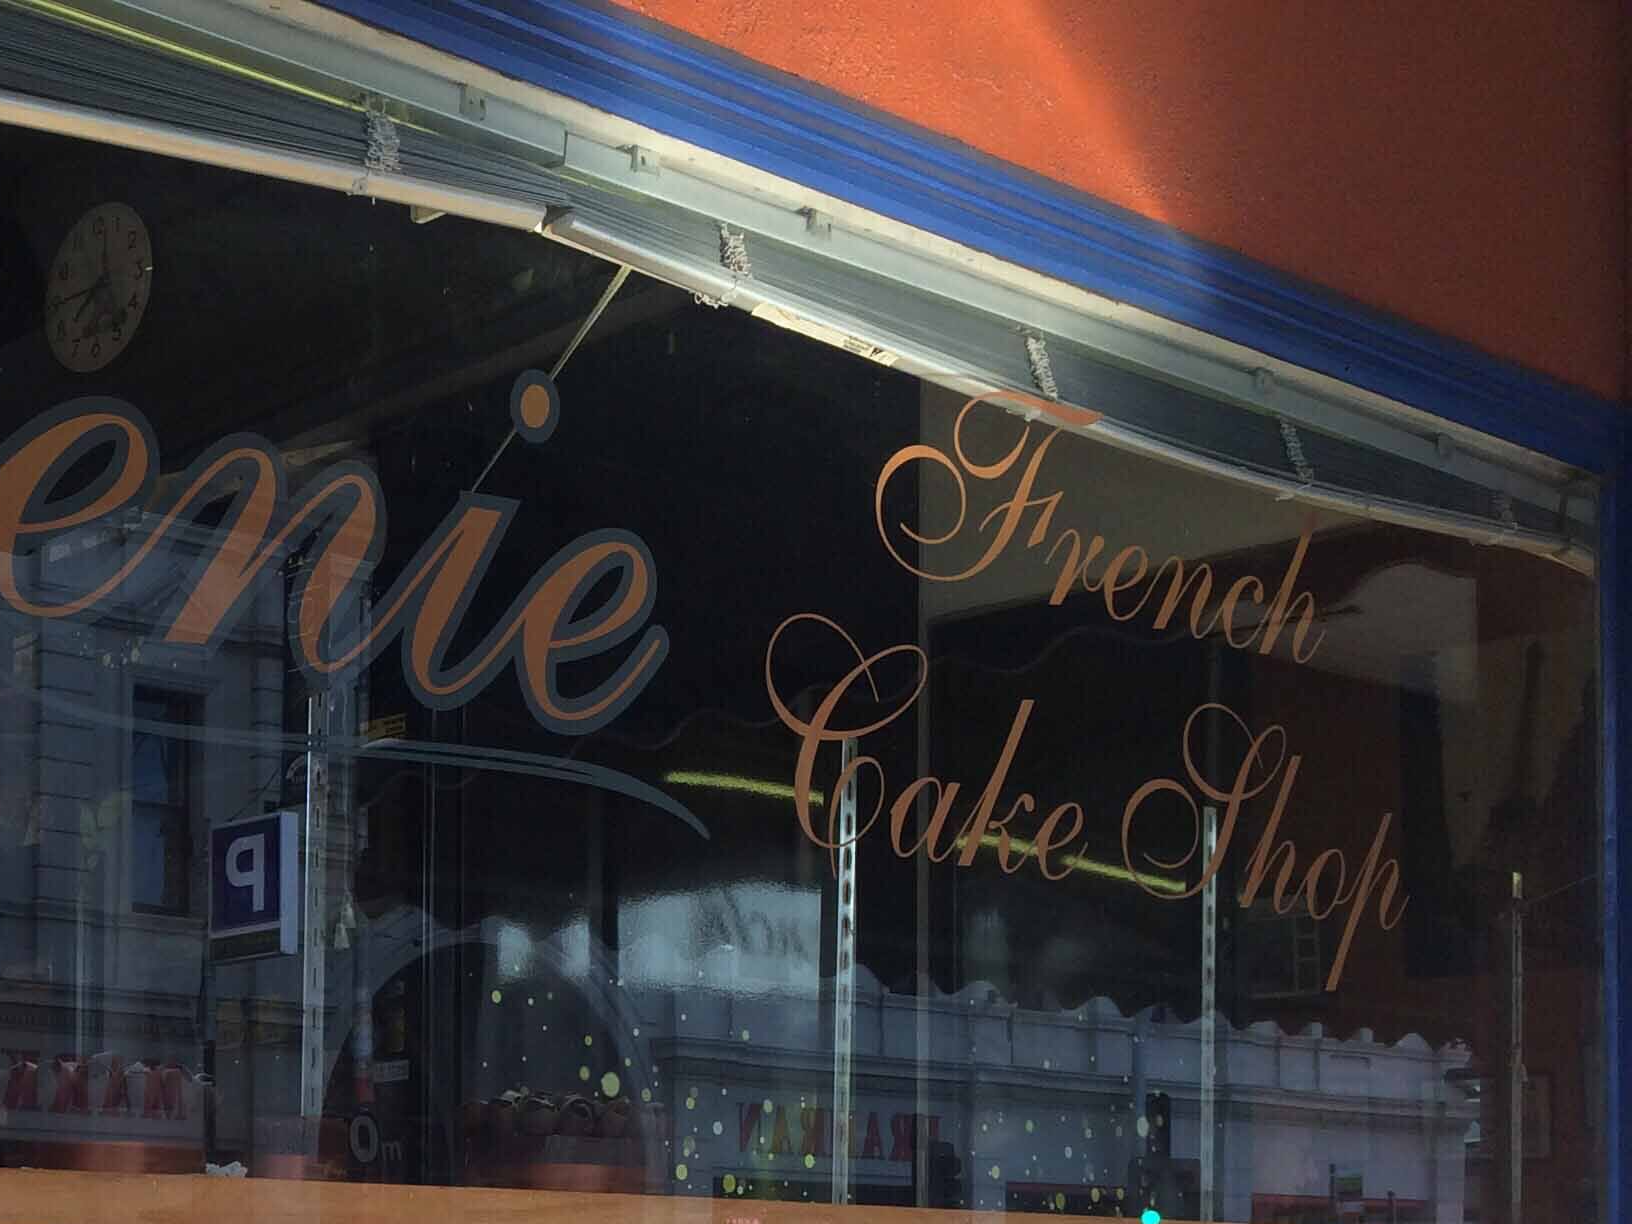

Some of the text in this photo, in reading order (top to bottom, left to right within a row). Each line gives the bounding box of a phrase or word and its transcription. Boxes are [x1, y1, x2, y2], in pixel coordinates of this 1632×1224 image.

[875, 390, 1326, 665] French
[766, 613, 1410, 992] Cake Shop
